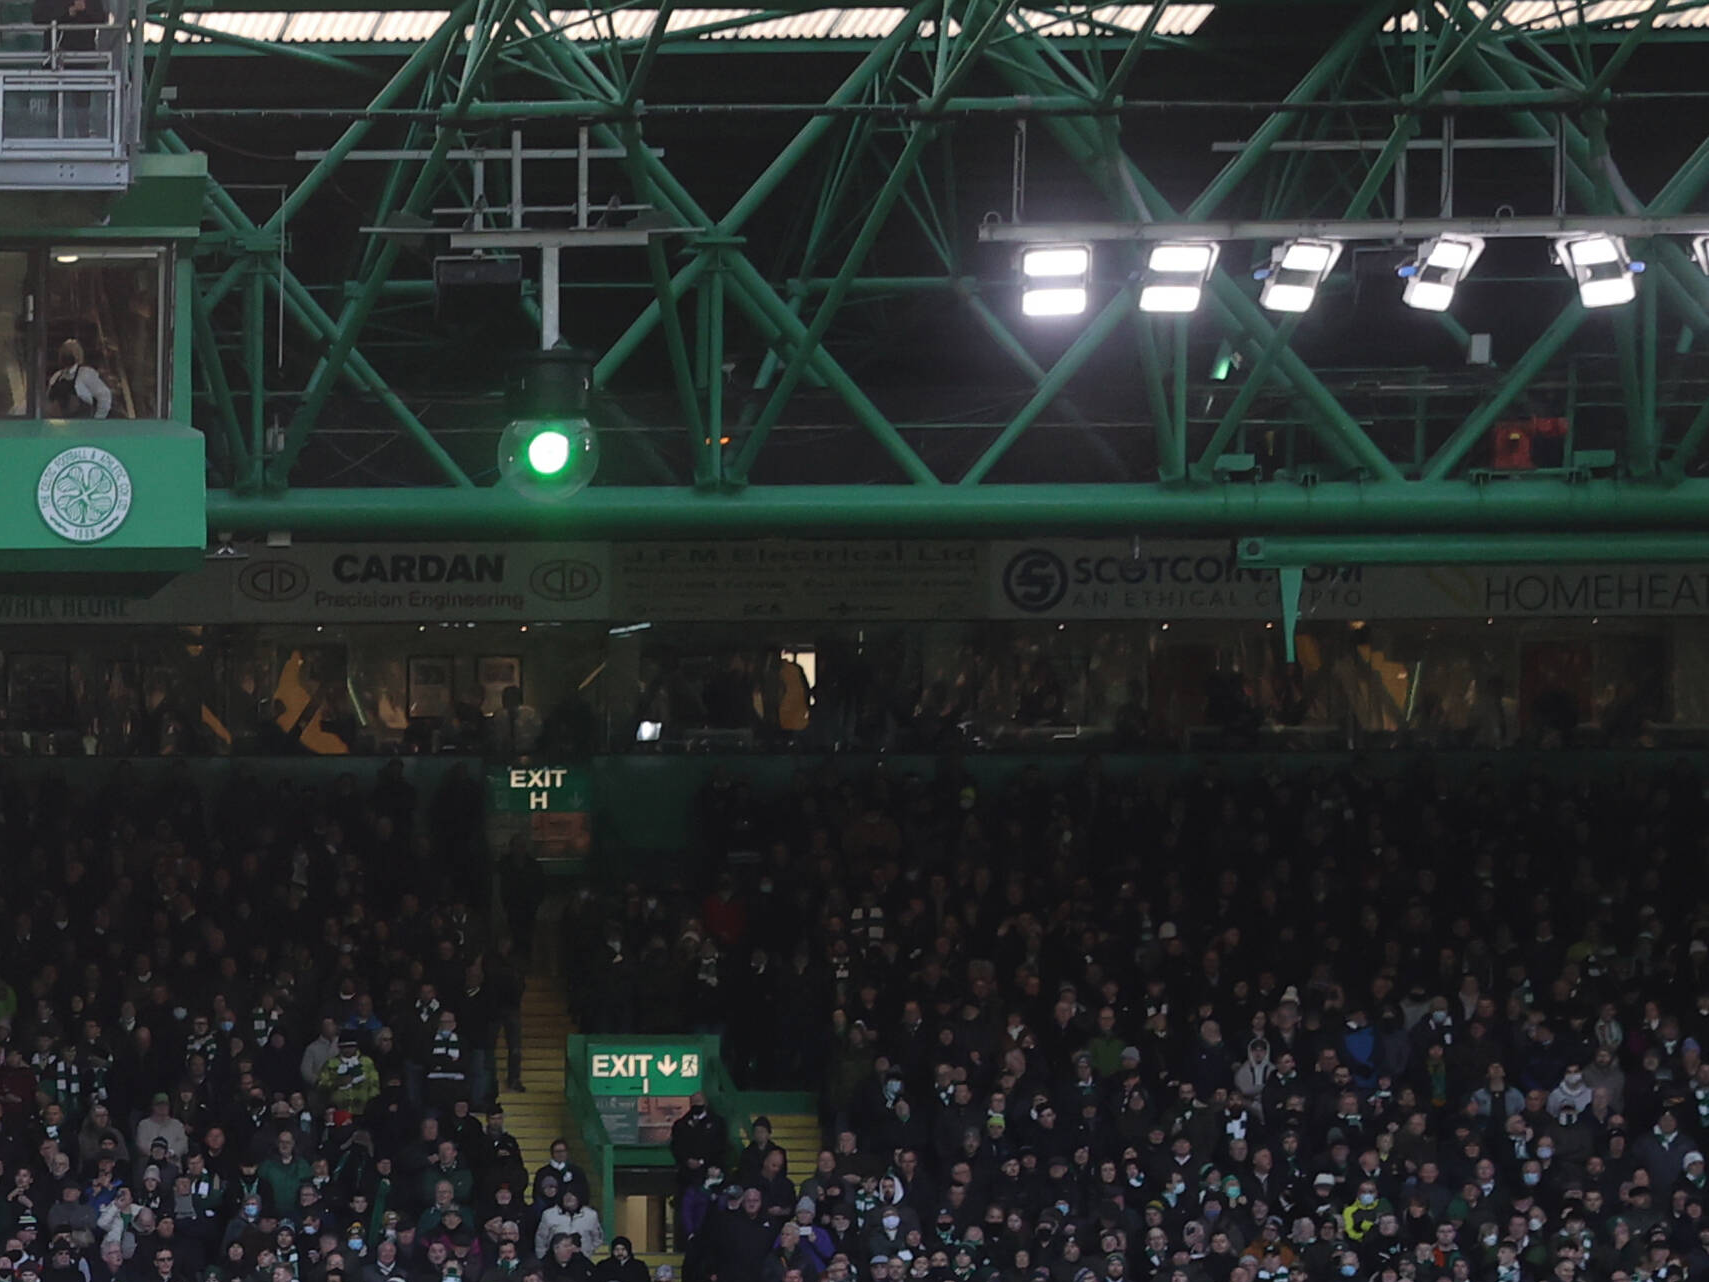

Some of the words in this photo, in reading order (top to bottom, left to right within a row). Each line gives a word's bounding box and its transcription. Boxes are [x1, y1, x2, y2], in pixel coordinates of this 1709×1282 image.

[332, 553, 506, 584] CARDAN
[1072, 556, 1363, 585] SCOTCOIN.OM
[314, 590, 406, 609] Precision
[409, 590, 525, 611] Engineering
[1072, 590, 1108, 608] AN
[1124, 590, 1238, 608] ETHICAL
[510, 769, 568, 788] EXIT
[529, 791, 548, 810] H
[592, 1054, 653, 1077] EXIT
[643, 1078, 649, 1095] I
